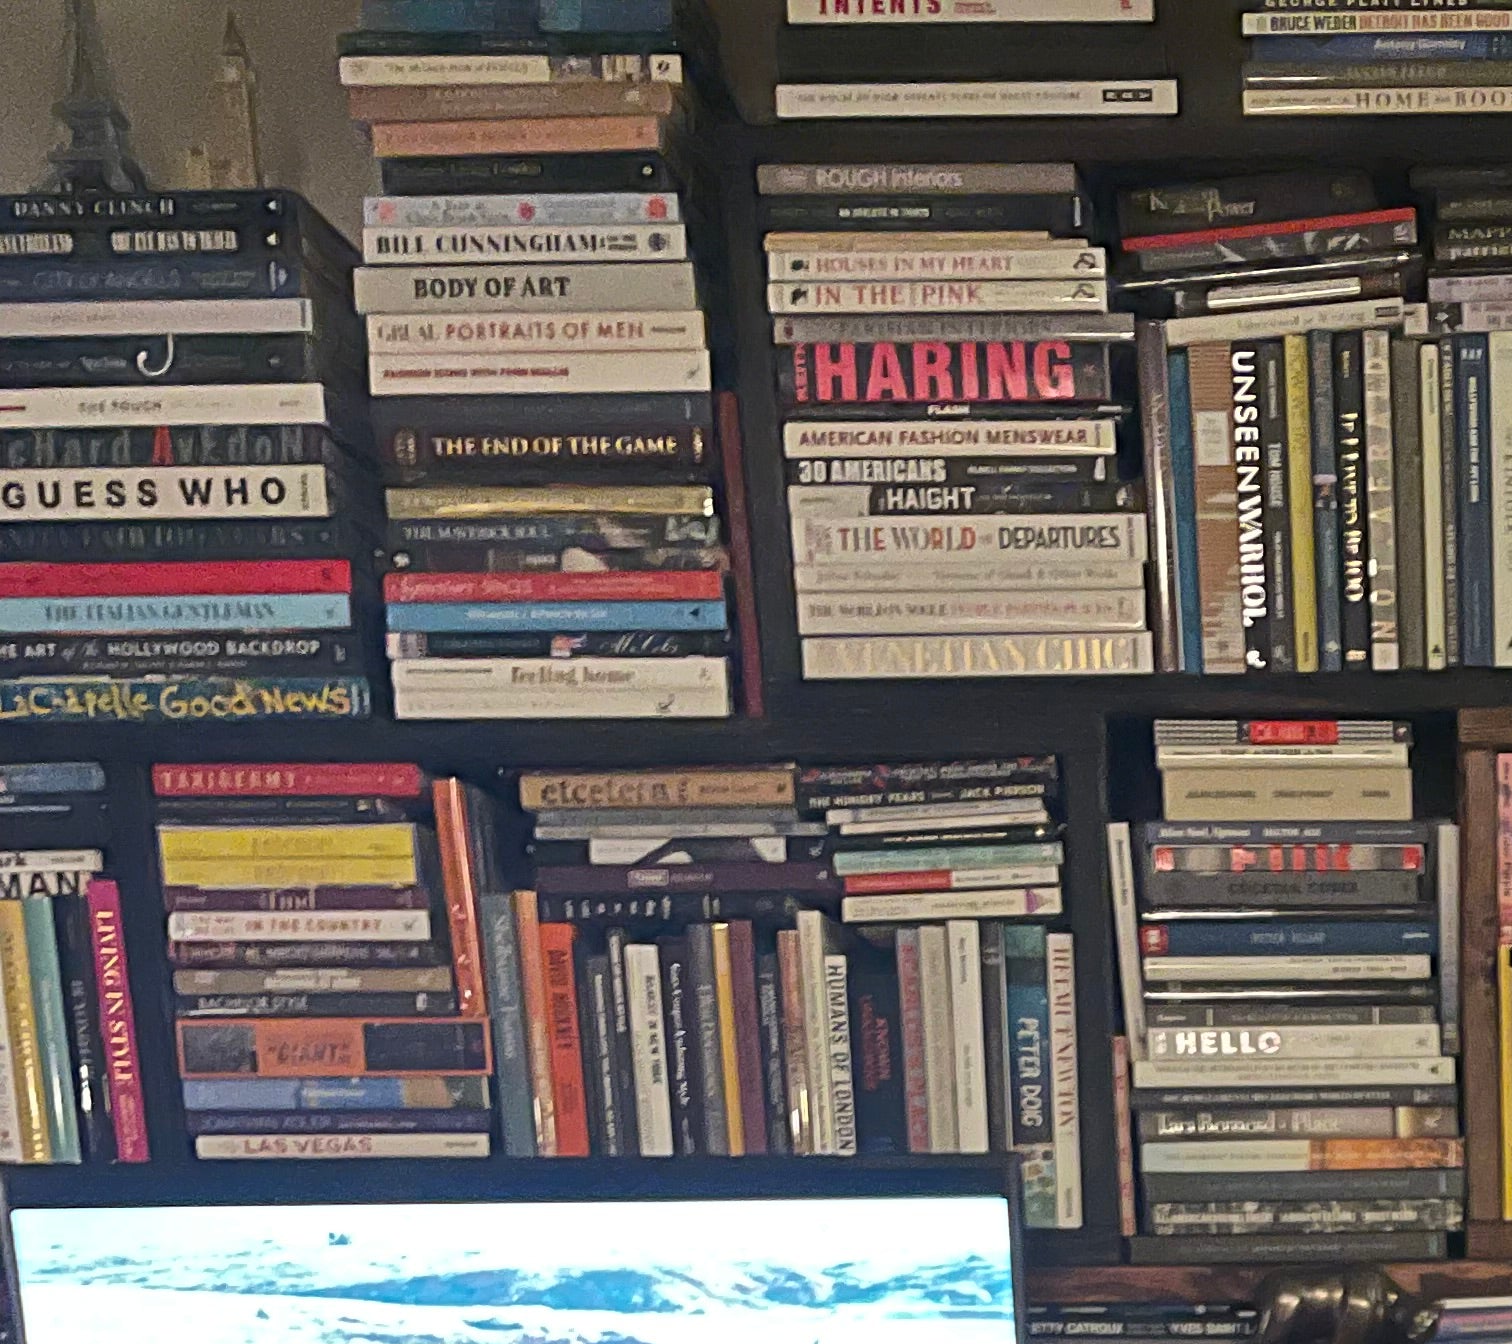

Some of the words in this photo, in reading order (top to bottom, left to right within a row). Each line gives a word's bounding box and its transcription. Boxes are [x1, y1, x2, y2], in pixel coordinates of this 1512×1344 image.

[414, 277, 477, 299] BODY
[485, 278, 513, 298] OF
[521, 275, 572, 297] ART
[813, 340, 1076, 401] HARING
[431, 437, 477, 456] THE
[532, 436, 563, 456] OF
[566, 436, 612, 455] THE
[615, 436, 678, 456] GAME
[830, 458, 947, 483] AMERICANS
[1, 478, 158, 509] GUESS
[178, 477, 287, 506] WHO
[837, 528, 888, 552] THE
[999, 525, 1121, 551] DEPARTURES
[828, 964, 849, 1044] HUMANS
[1174, 1031, 1282, 1055] HELLO
[834, 1078, 856, 1152] LONDON
